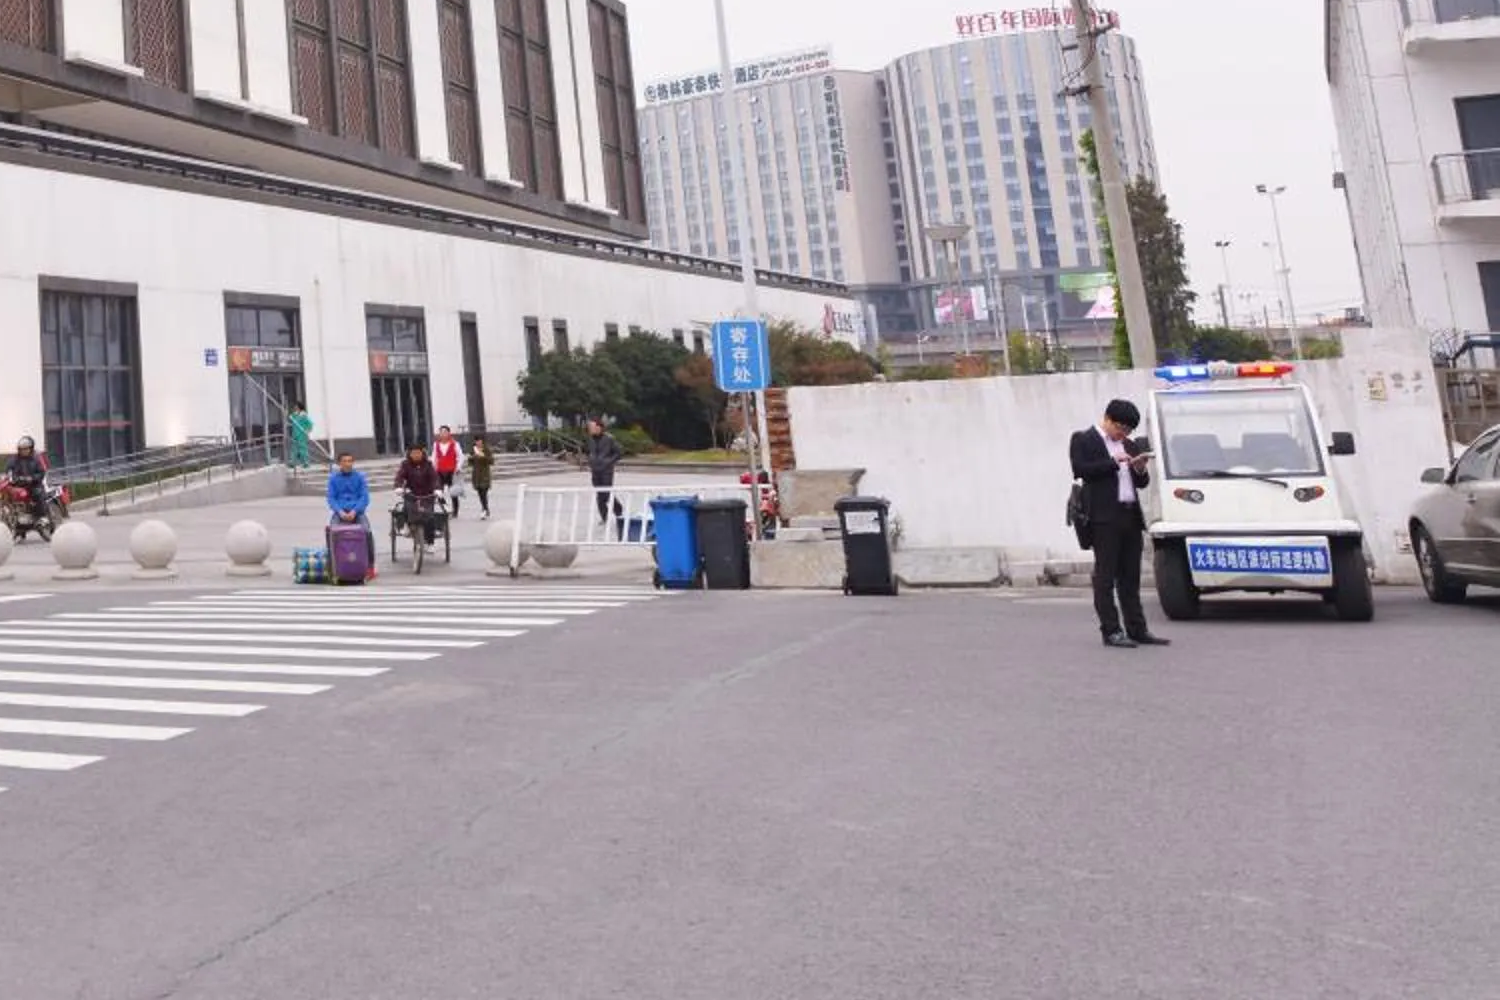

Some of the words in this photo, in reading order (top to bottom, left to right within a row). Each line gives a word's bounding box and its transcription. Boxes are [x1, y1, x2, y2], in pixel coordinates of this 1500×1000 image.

[657, 65, 759, 101] 格林豪泰快酒店
[730, 327, 753, 383] 寄存处
